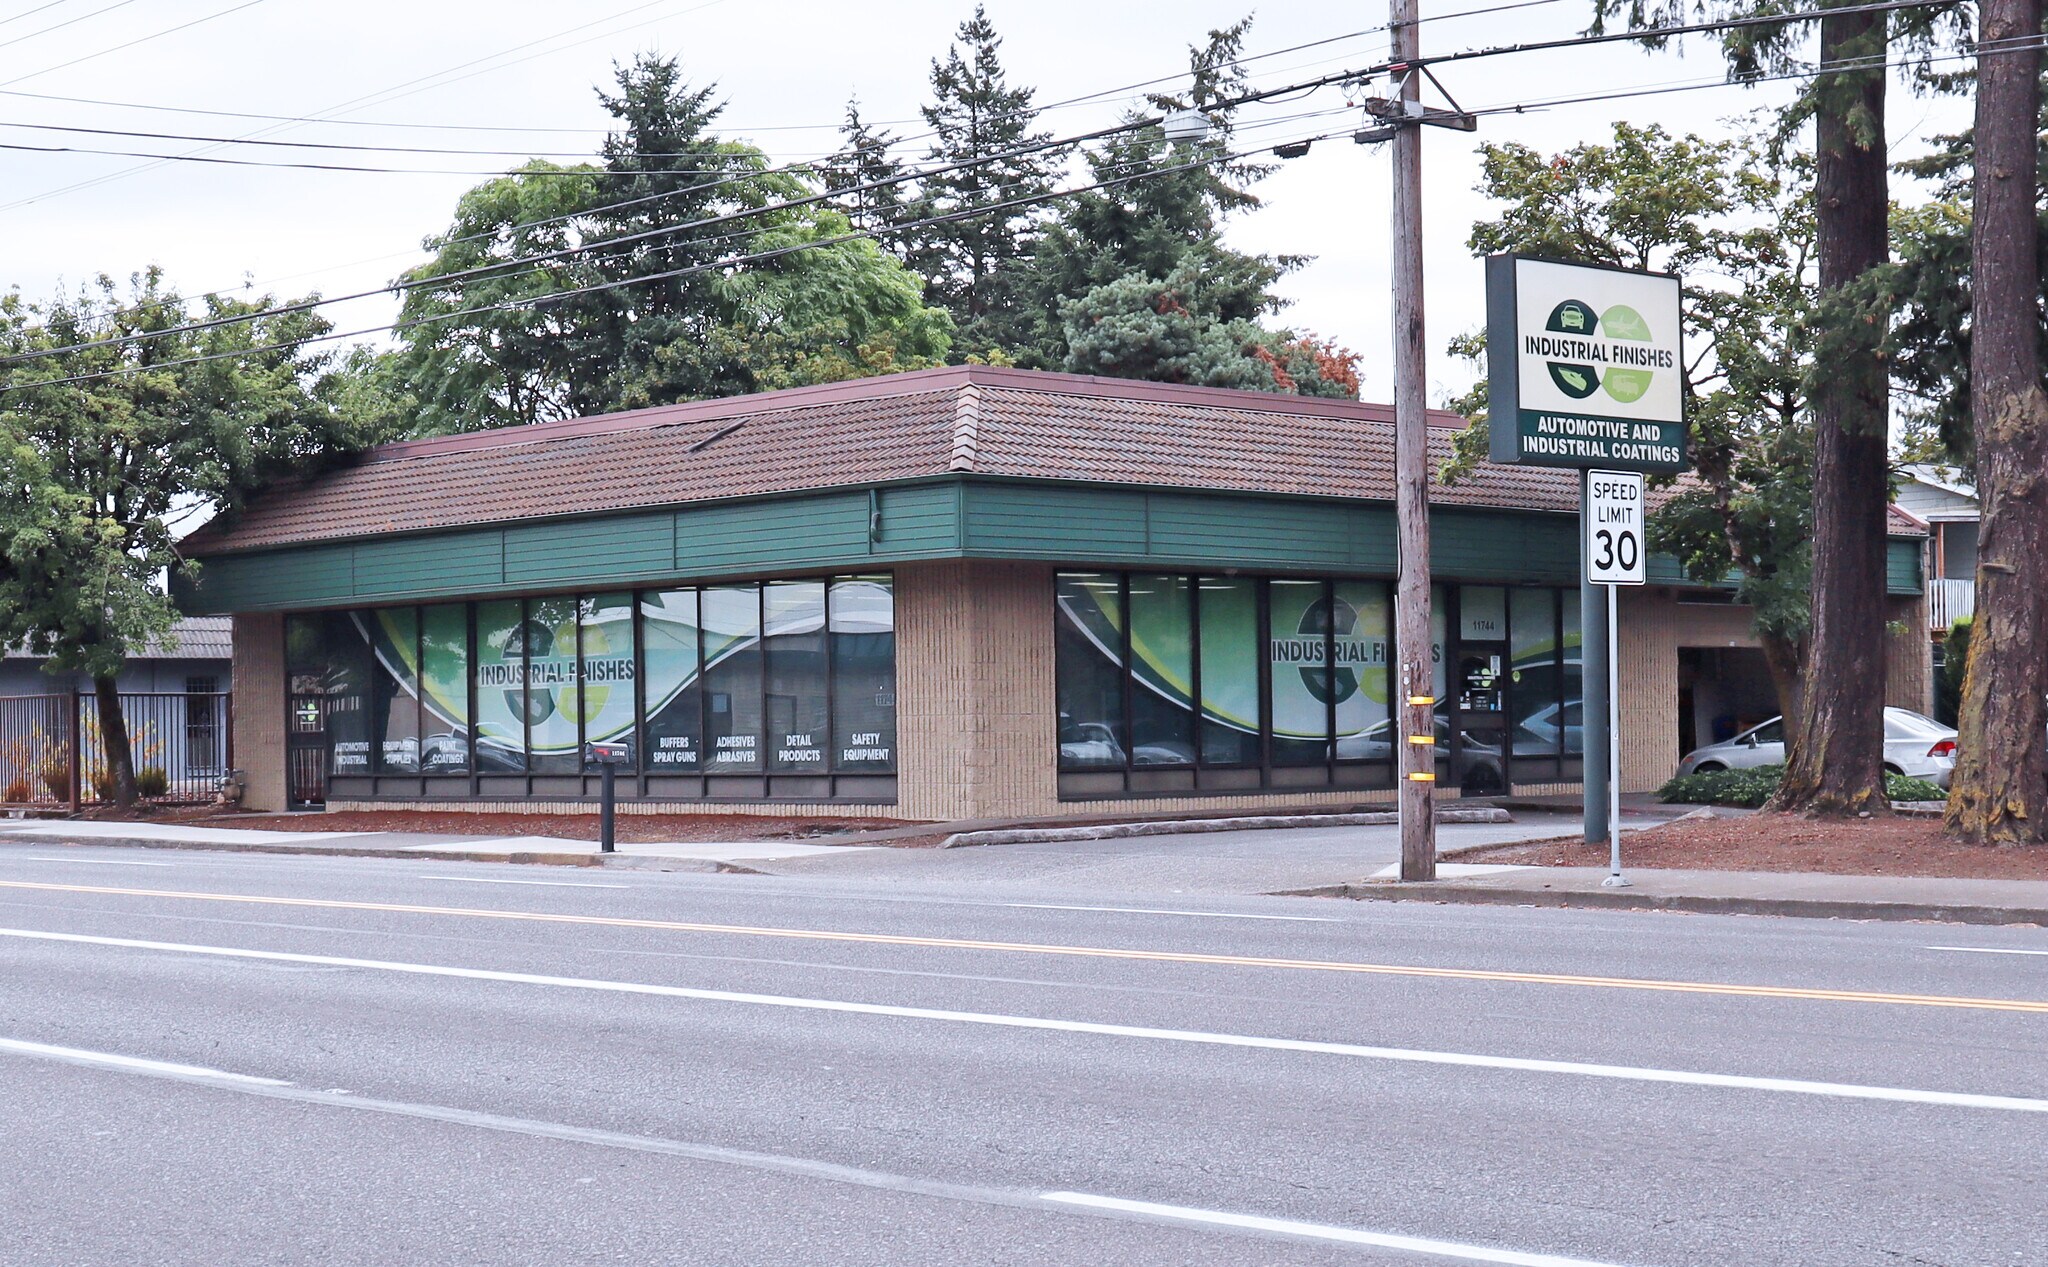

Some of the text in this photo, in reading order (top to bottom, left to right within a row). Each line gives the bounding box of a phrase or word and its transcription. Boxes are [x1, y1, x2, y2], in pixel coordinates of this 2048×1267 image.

[1525, 335, 1673, 369] INDUSTRIAL FINISHES
[1537, 416, 1660, 441] AUTOMOTIVE AND
[1523, 436, 1680, 463] INDUSTRIAL COATINGS
[1593, 482, 1637, 501] SPEED
[1598, 505, 1633, 524] LIMIT
[1595, 529, 1638, 571] 30
[1473, 620, 1495, 631] 11744
[1272, 641, 1368, 662] INDUSRIAL
[481, 659, 635, 685] INDUSRIAL FNISHES
[382, 741, 415, 751] EQUIPMENT
[659, 736, 689, 748] BUFFERS
[716, 735, 756, 748] ADHESIVES
[786, 734, 812, 747] DETAIL
[851, 733, 881, 746] SAFETY
[335, 742, 369, 752] AUTOMOTIVE
[336, 754, 368, 765] INDUSTRIAL
[386, 754, 412, 764] SUPPLIES
[432, 753, 464, 764] COATINGS
[653, 751, 697, 763] SPRAY GUNS
[716, 750, 756, 763] ABRASIVES
[778, 749, 821, 762] PRODUCTS
[843, 748, 890, 761] EQUIPMENT
